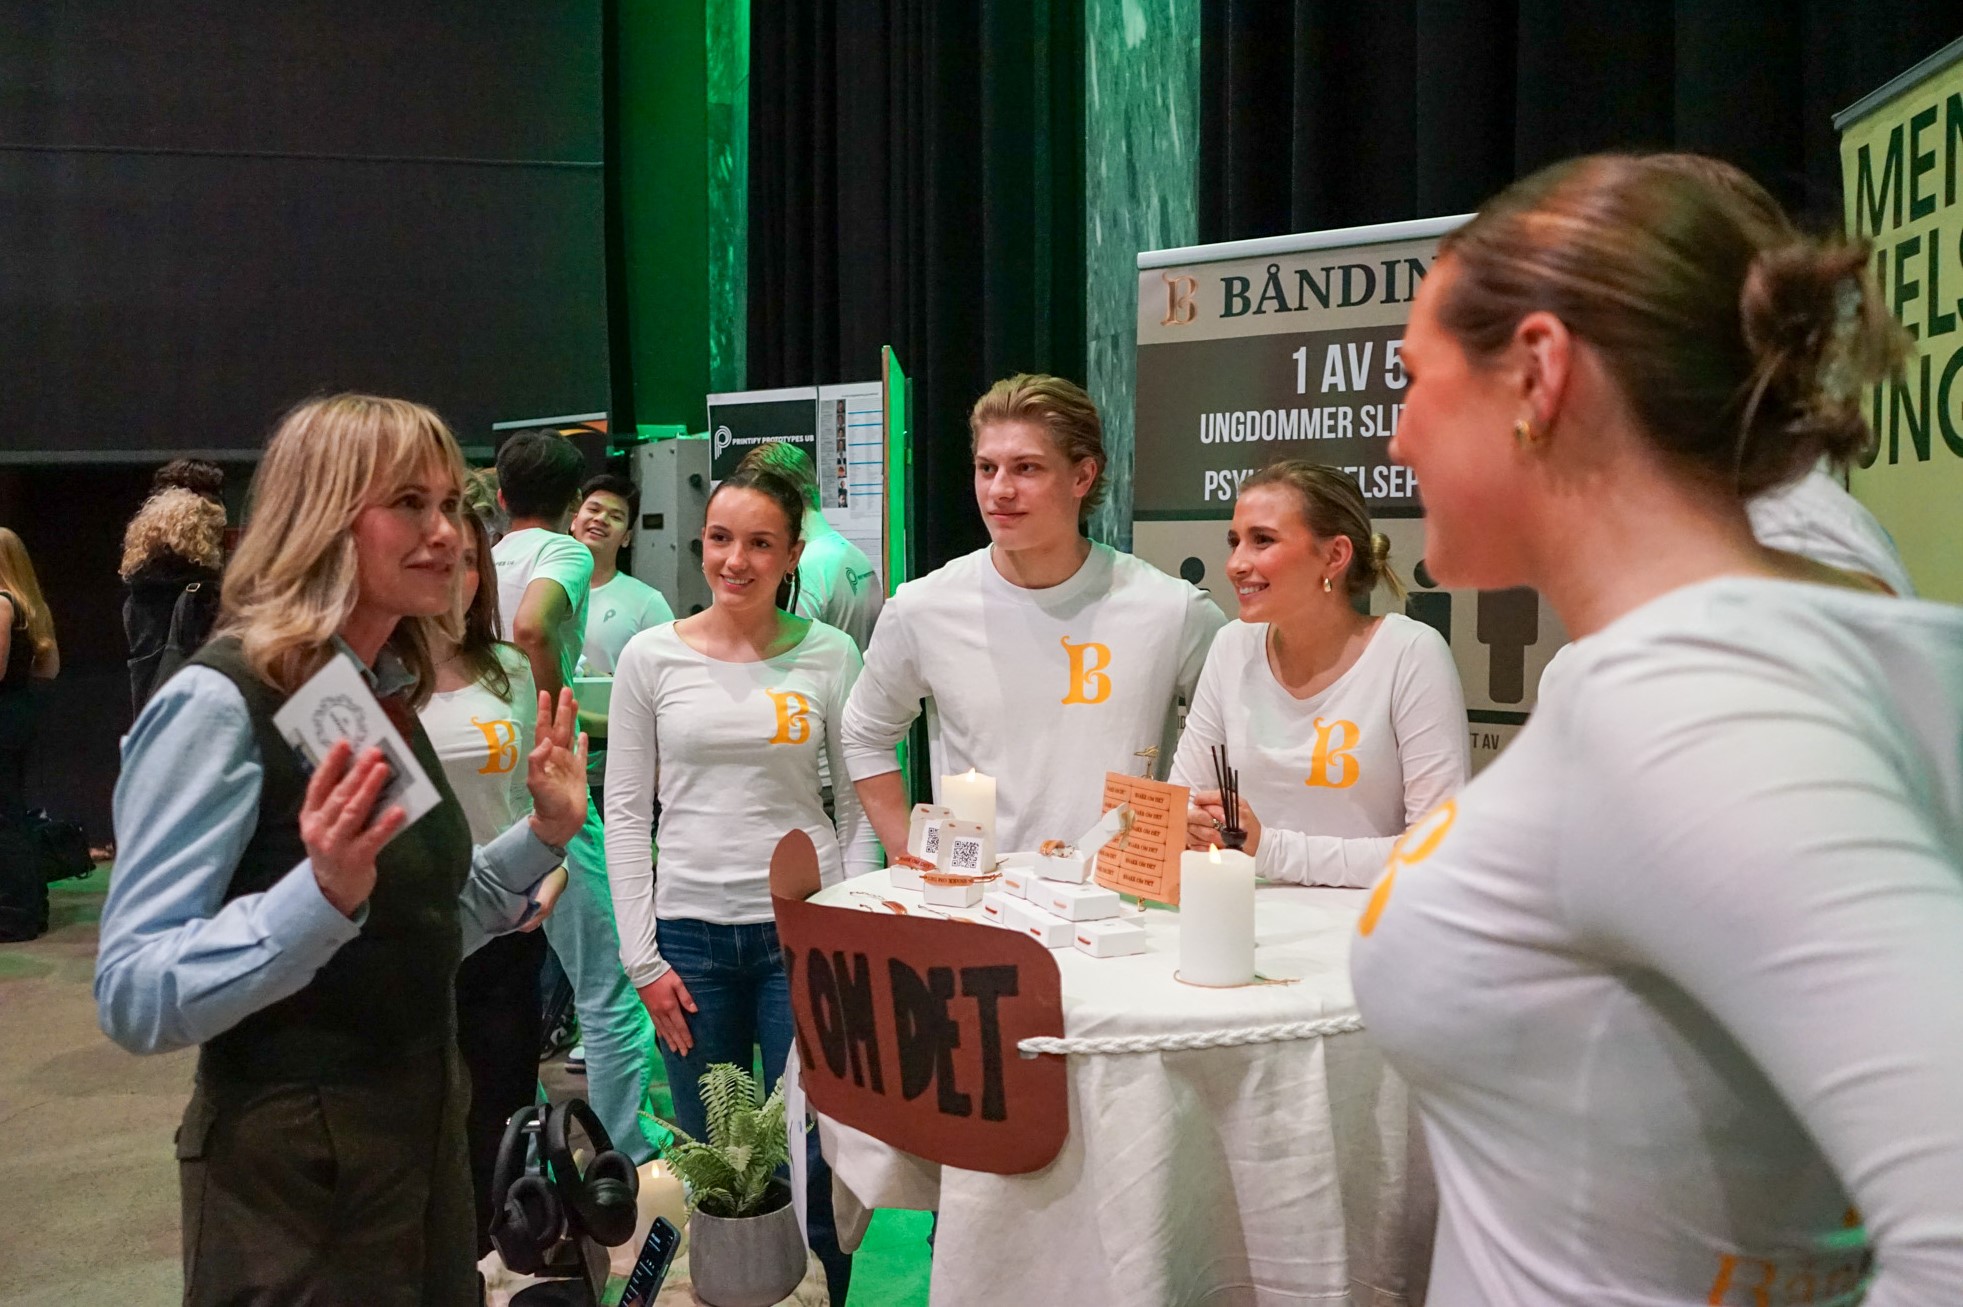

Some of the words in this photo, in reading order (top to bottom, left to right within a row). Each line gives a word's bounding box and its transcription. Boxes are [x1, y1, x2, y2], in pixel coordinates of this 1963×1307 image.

[1292, 346, 1308, 395] 1
[1321, 341, 1372, 394] AV
[732, 437, 761, 446] PRINTIFY
[762, 434, 803, 444] PROTOTYPES
[1200, 406, 1353, 444] UNGDOMMER
[1061, 634, 1112, 705] B
[471, 716, 518, 774] B
[766, 688, 811, 746] B
[1482, 733, 1500, 750] AV
[1305, 717, 1361, 789] B
[887, 957, 1019, 1122] DET
